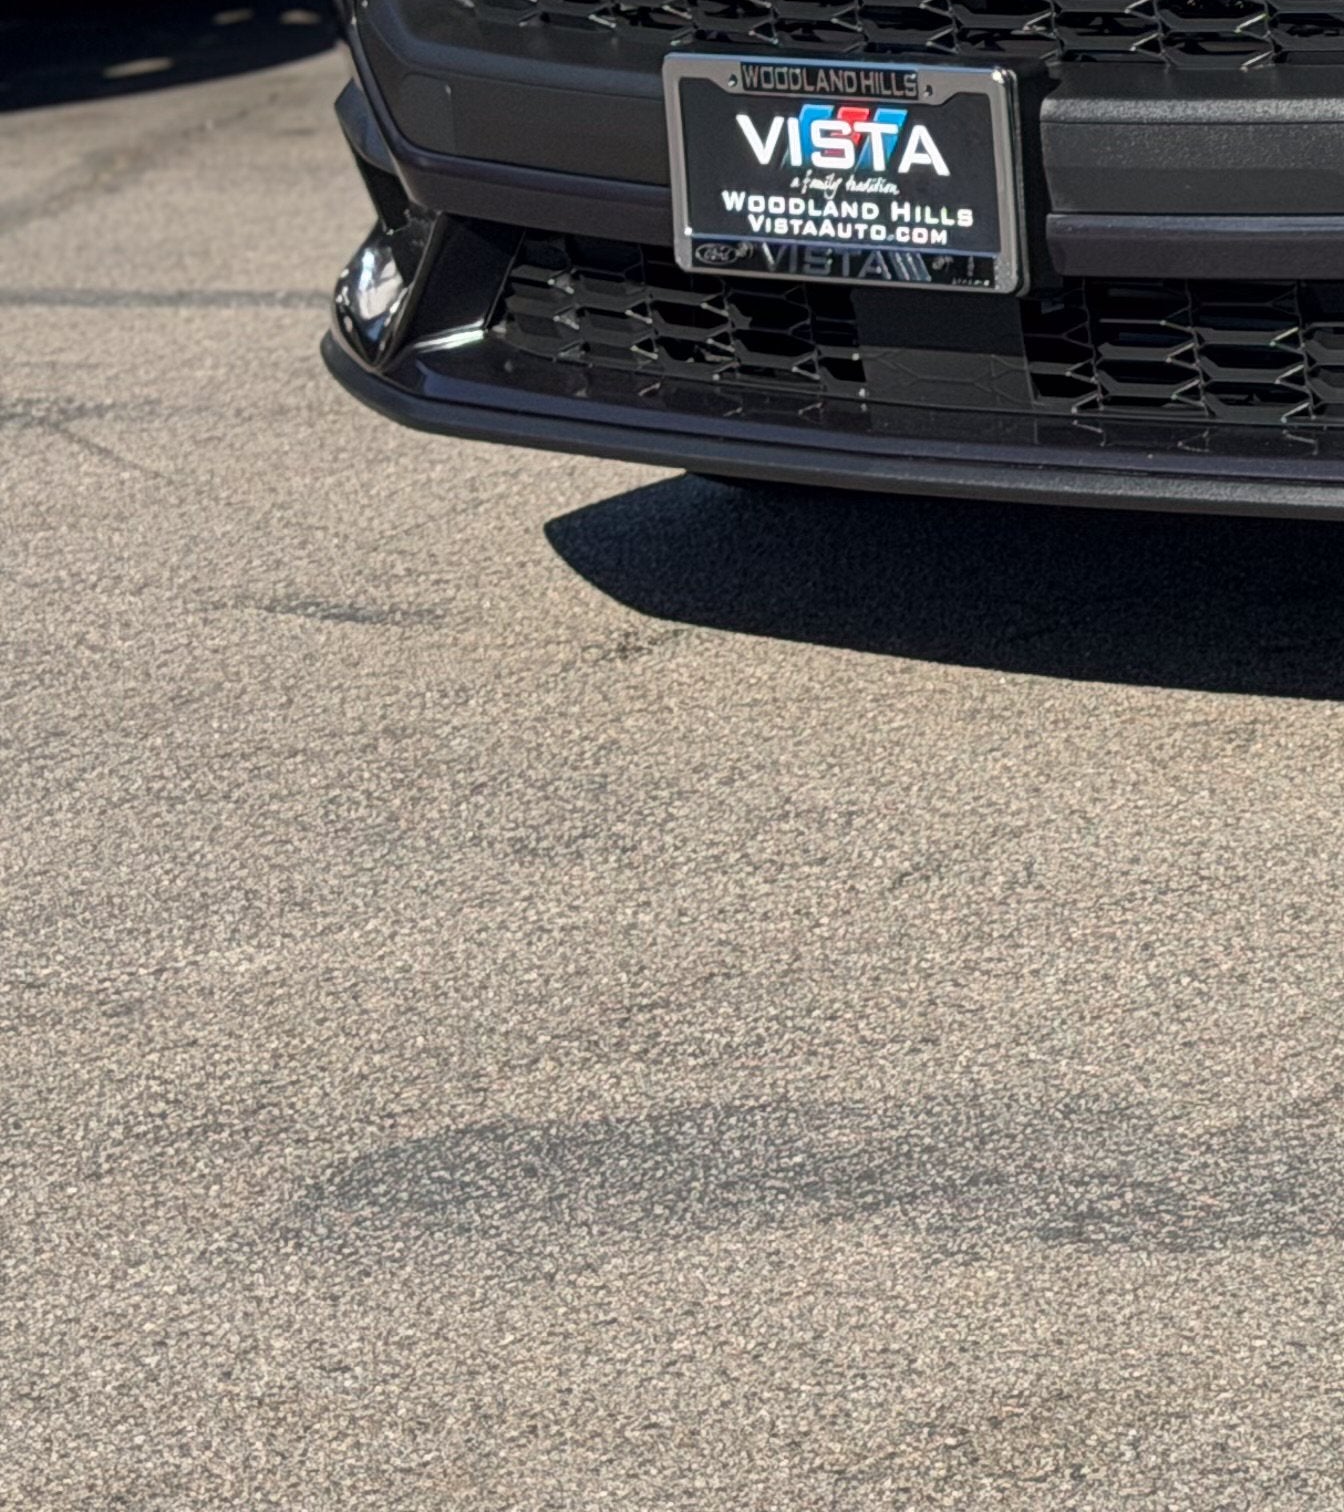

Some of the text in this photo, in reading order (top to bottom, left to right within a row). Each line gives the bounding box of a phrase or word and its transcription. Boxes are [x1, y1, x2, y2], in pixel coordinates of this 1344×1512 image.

[742, 64, 918, 98] WOODLAND HILLS
[735, 113, 951, 177] VISTA
[799, 169, 844, 199] family
[845, 174, 901, 196] tradition
[721, 189, 974, 228] WOODLAND HILLS
[763, 242, 892, 280] VISTA
